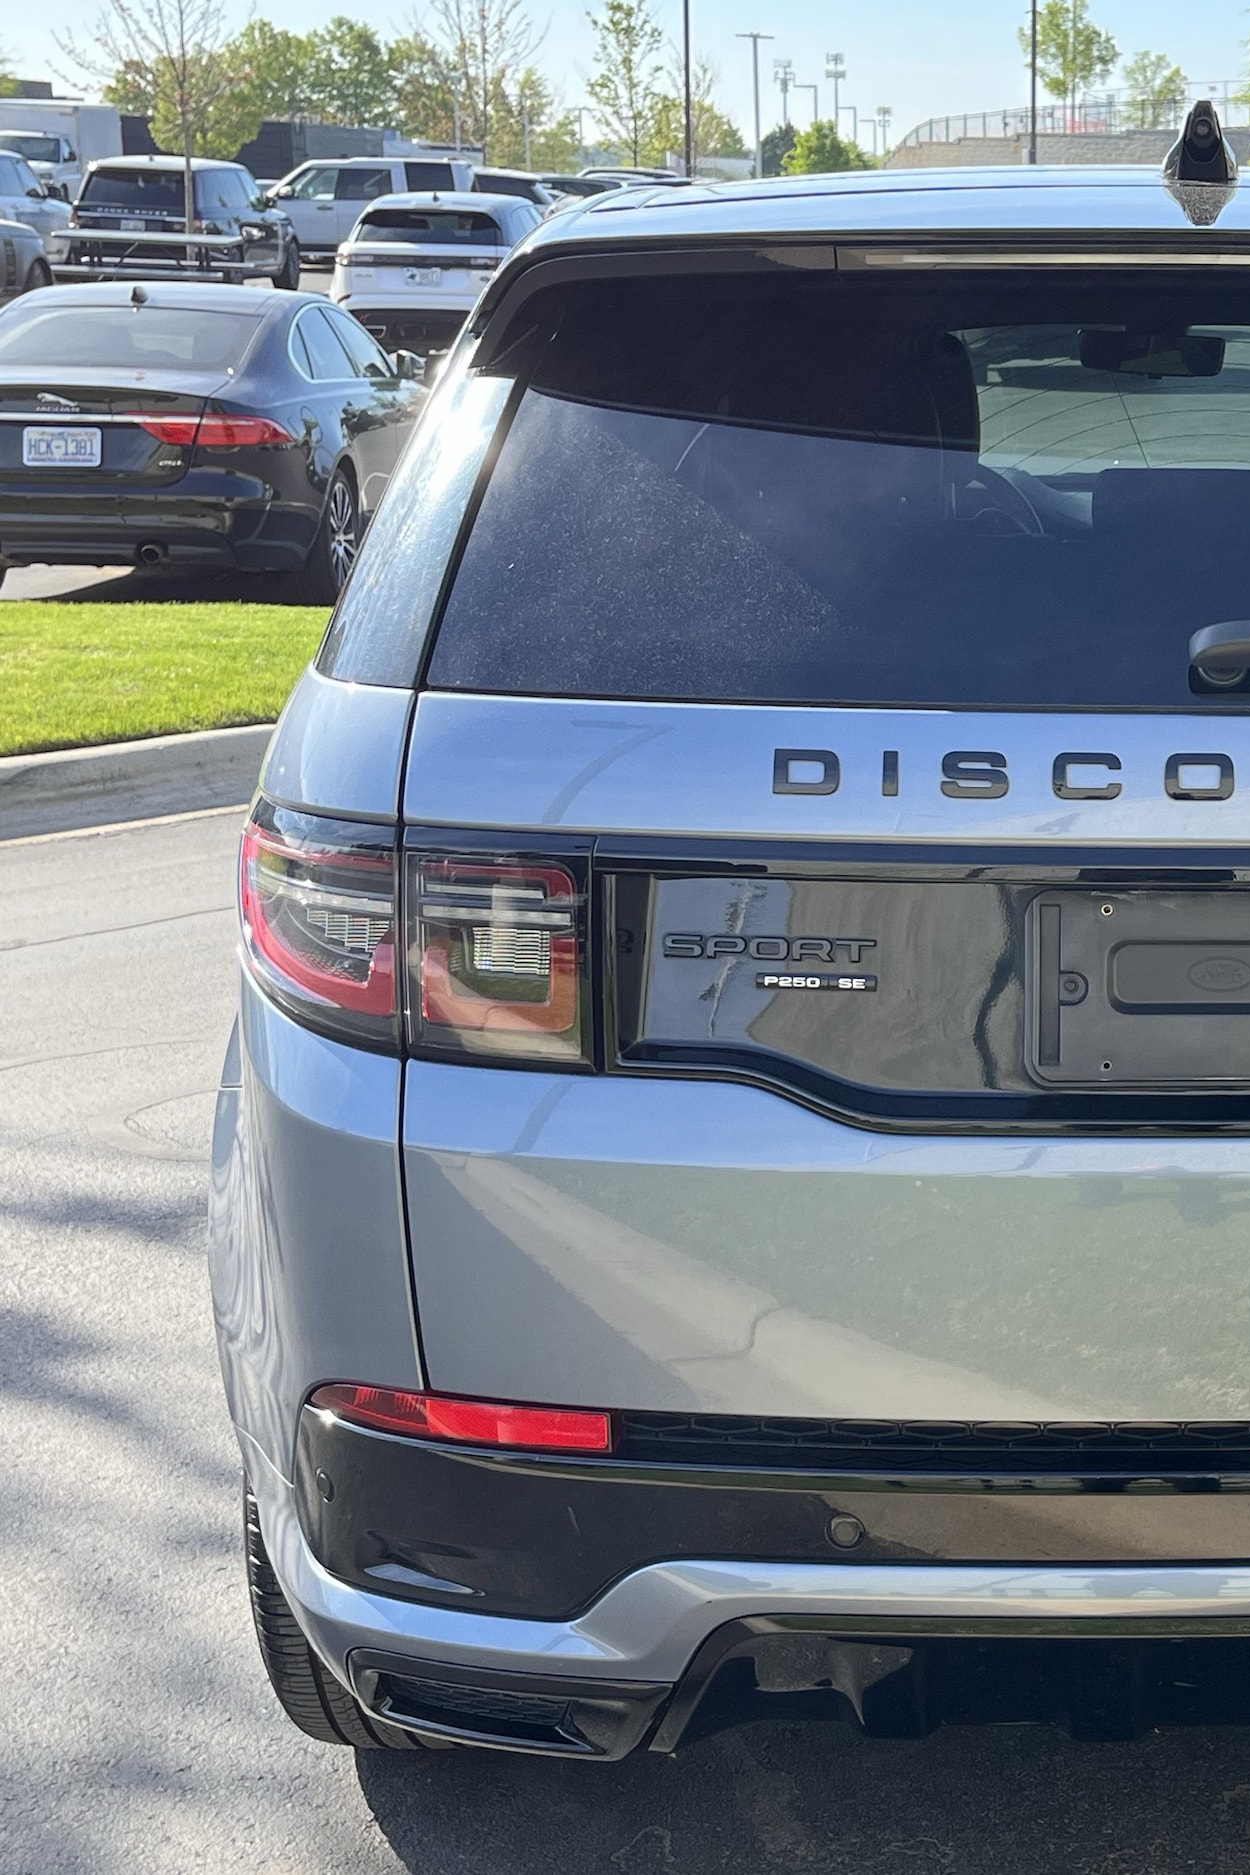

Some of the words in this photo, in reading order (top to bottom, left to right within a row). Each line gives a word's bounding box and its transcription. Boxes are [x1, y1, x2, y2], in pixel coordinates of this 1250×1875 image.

[28, 438, 96, 456] HCK-1381
[663, 933, 877, 964] SPORT
[763, 974, 821, 989] P250
[837, 976, 866, 990] SE
